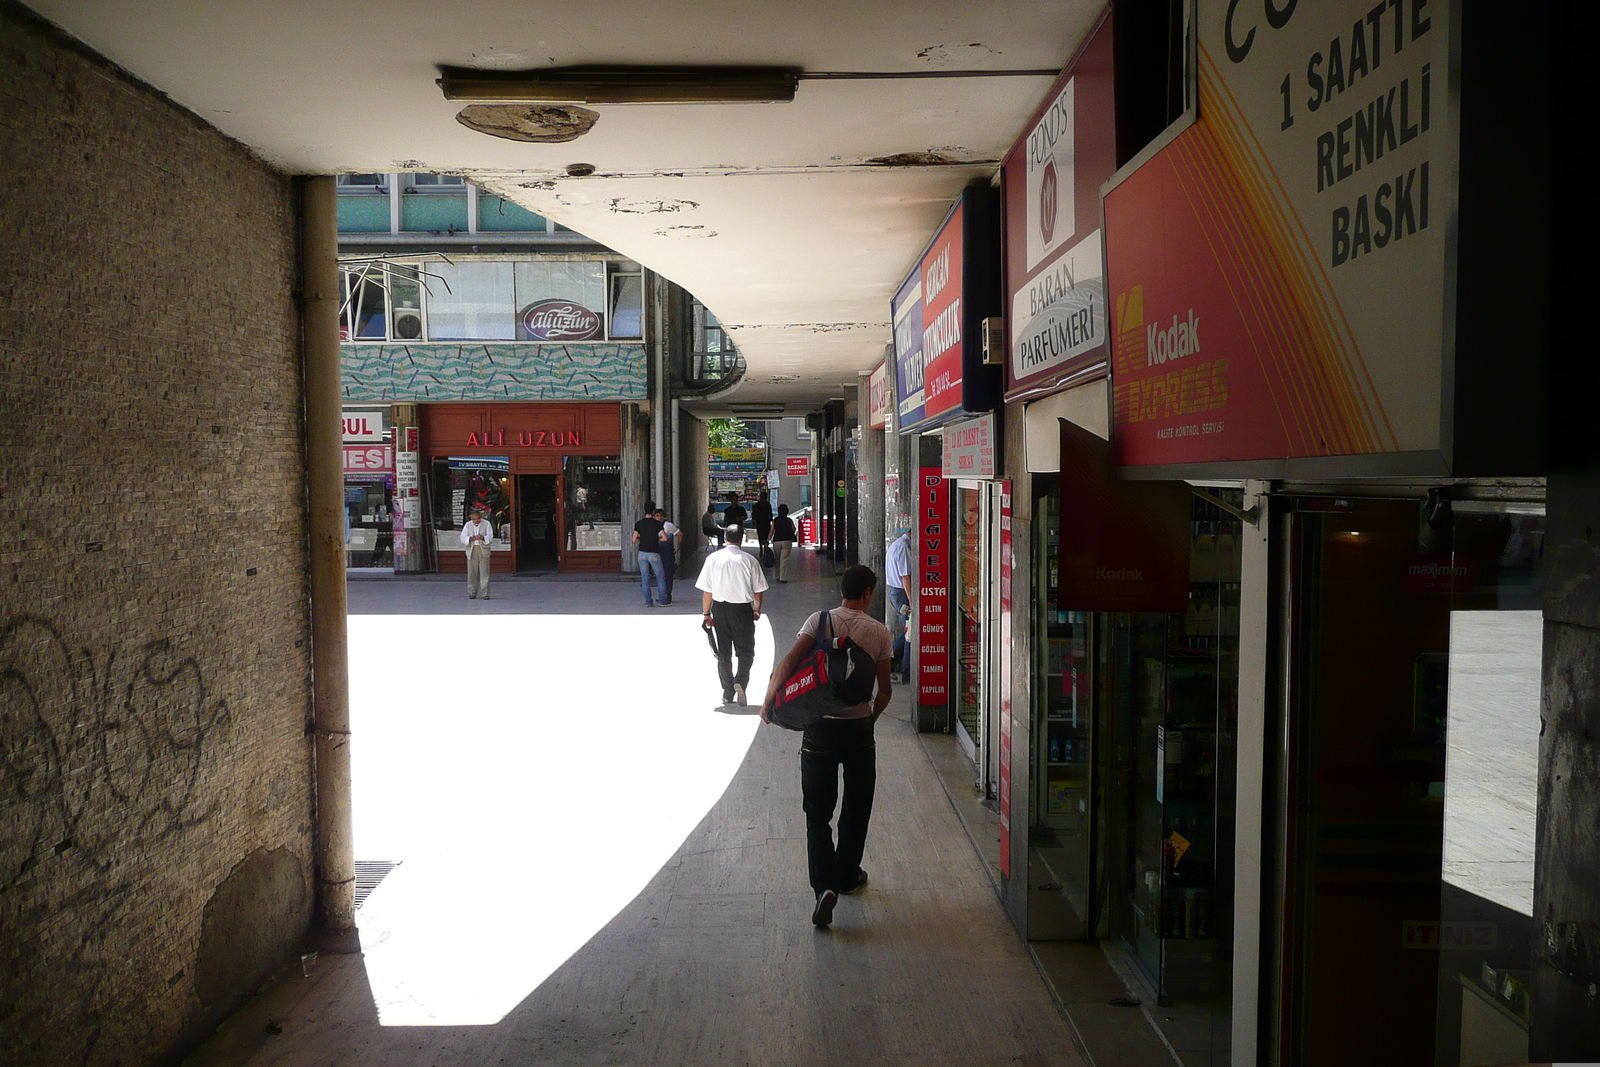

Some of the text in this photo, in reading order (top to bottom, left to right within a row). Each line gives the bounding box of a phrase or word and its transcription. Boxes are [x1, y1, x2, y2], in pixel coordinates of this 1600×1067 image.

[1281, 0, 1431, 132] 1 SAATTE
[1317, 62, 1431, 193] RENKLİ
[1332, 161, 1429, 267] BASKI
[1030, 257, 1075, 318] BARAN
[1021, 293, 1095, 370] PARFÜMERİ
[1147, 308, 1200, 367] Kodak
[1116, 357, 1230, 423] EXPRESS
[467, 429, 581, 446] ALİ UZUN
[1175, 423, 1200, 437] KONTROL
[925, 476, 941, 583] DİLAVER
[1095, 566, 1143, 581] Kodak
[921, 587, 946, 596] USTA
[925, 605, 942, 613] ALTIN
[922, 624, 944, 634] GÜMÜŞ
[921, 644, 945, 654] GÖZLÜK
[923, 664, 944, 673] TAMİRİ
[921, 685, 945, 694] YAPILIR
